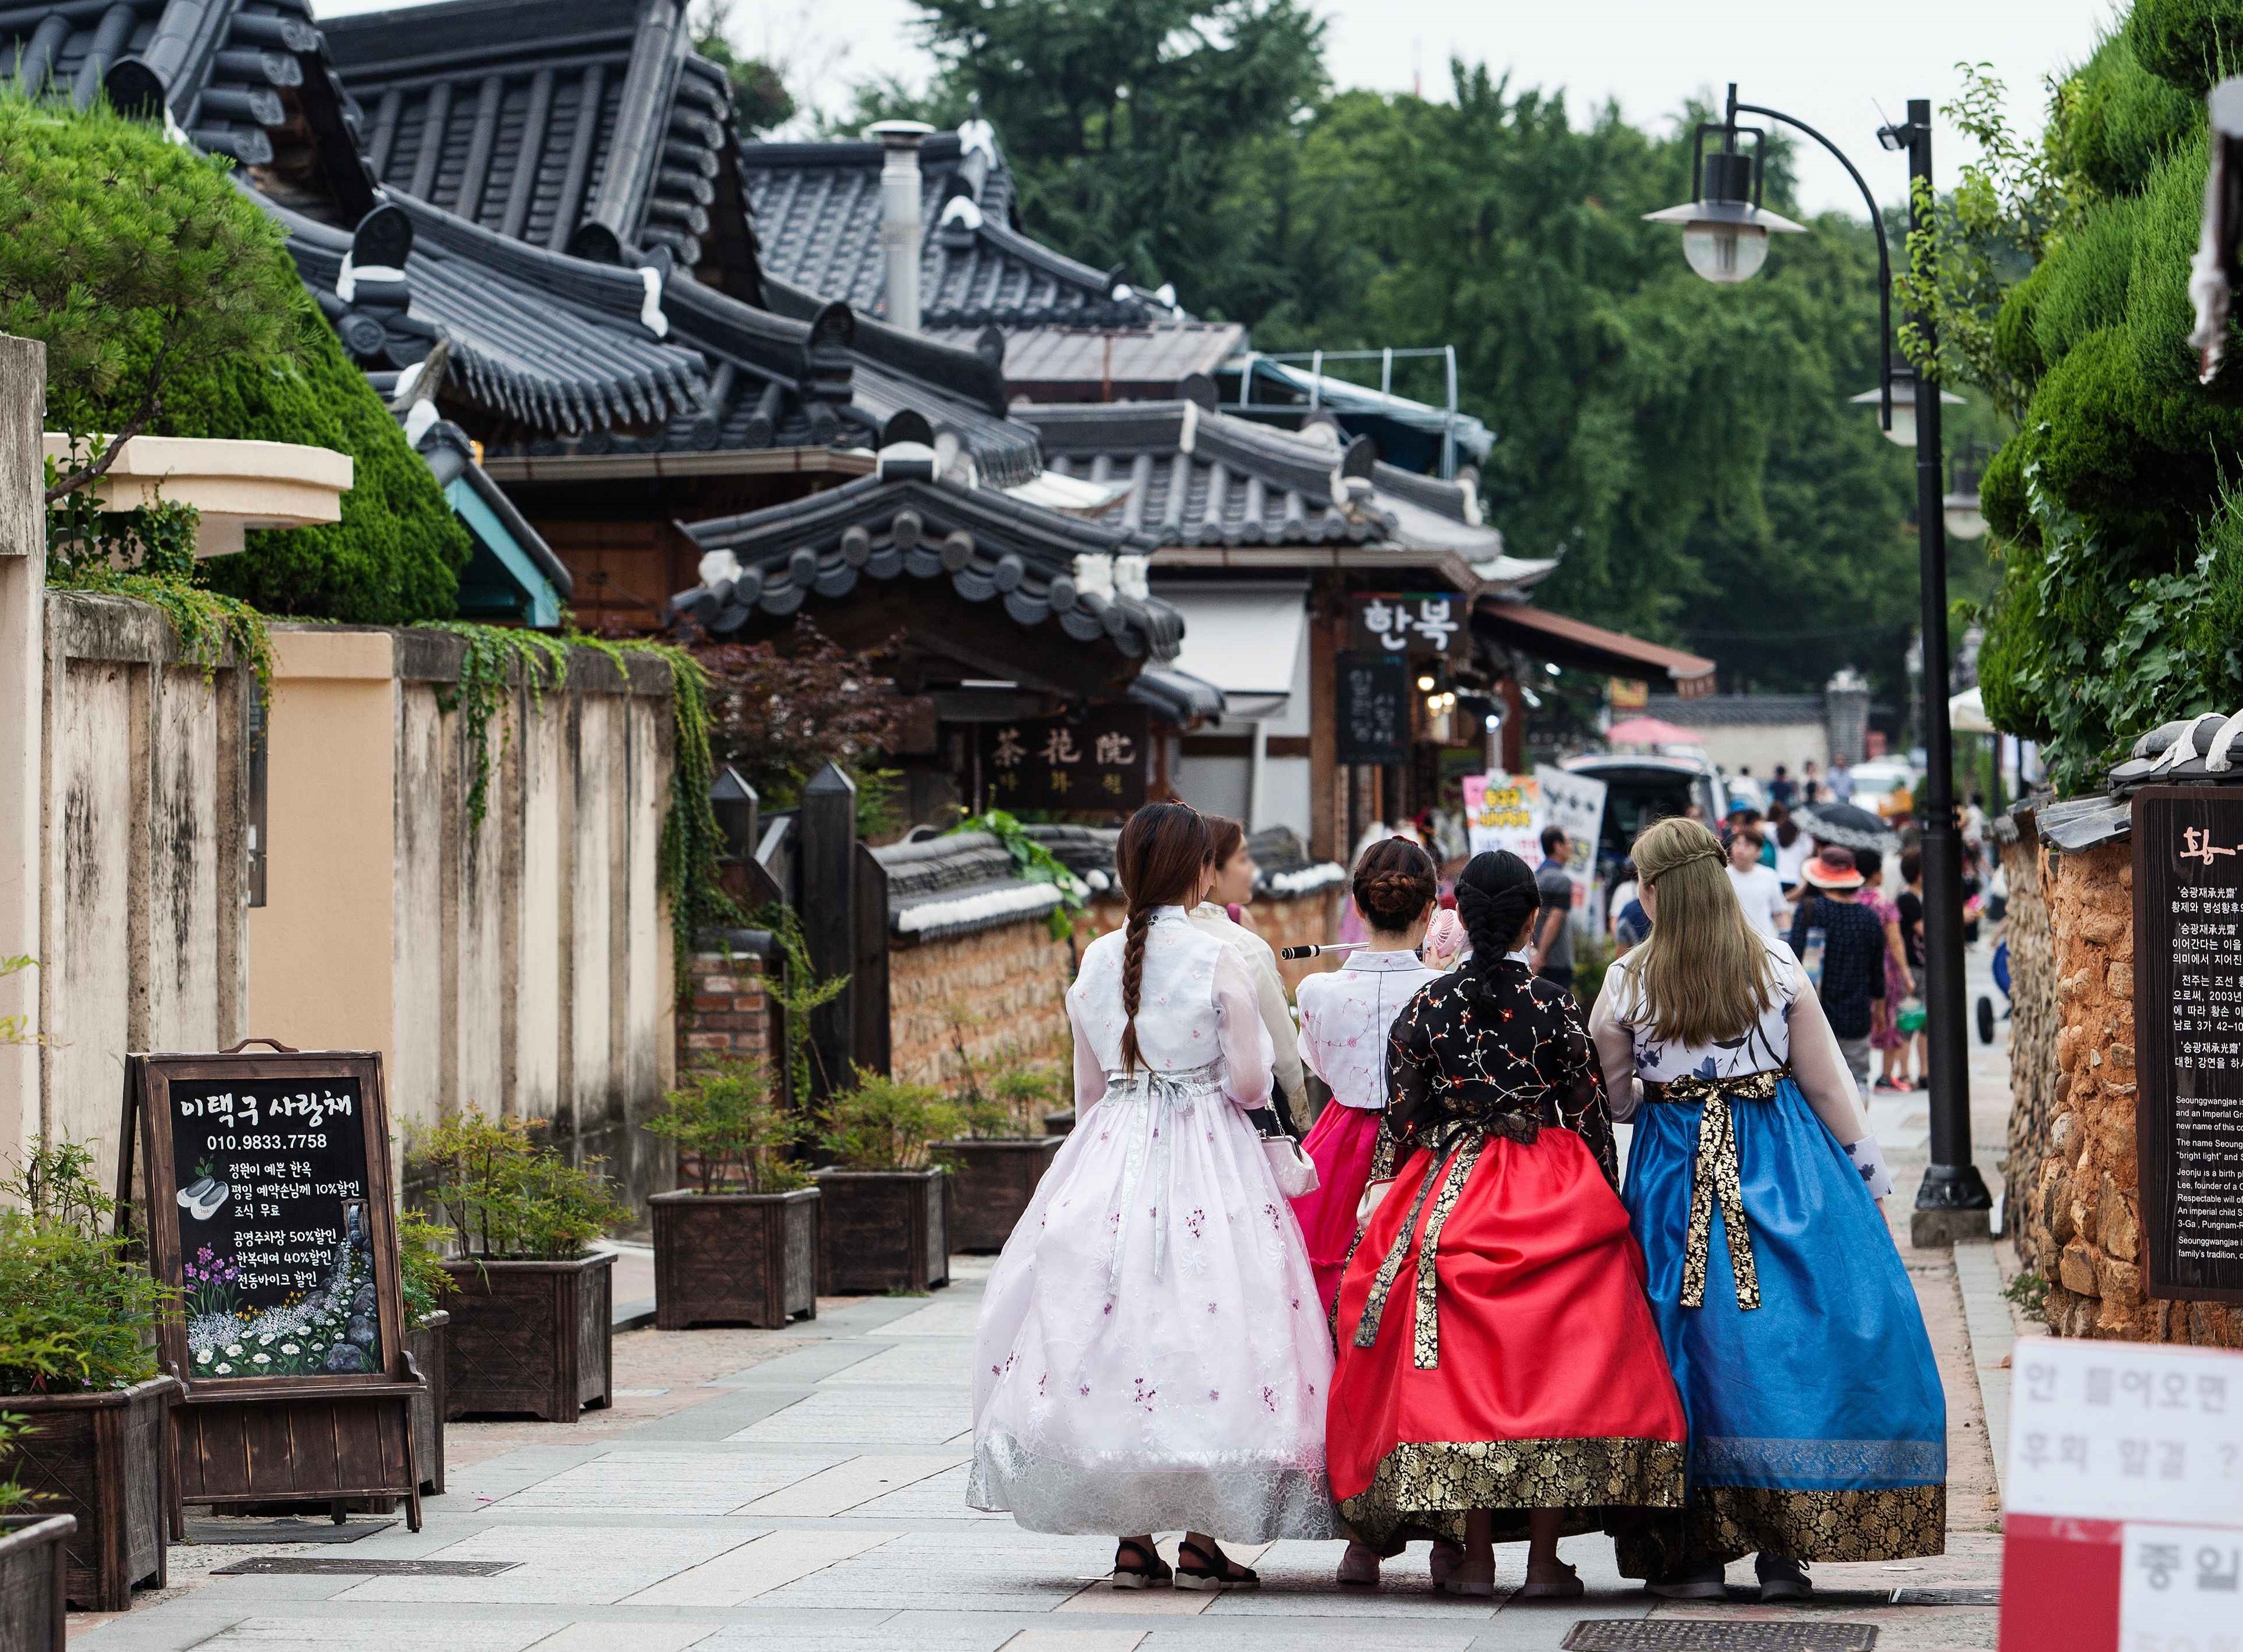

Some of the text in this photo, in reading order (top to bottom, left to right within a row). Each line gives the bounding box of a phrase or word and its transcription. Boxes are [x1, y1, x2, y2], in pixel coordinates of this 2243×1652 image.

[1362, 597, 1460, 652] 한복
[2180, 826, 2243, 865] 황
[2171, 901, 2243, 914] 황제와 명성황후
[2172, 938, 2219, 950] 이어간다는
[2172, 952, 2242, 966] 의미에서 지어진
[2182, 974, 2210, 987] 전주는
[2215, 976, 2233, 987] 조선
[2173, 990, 2242, 1003] 으로써, 2003년
[2173, 1005, 2182, 1016] 에
[2187, 1005, 2206, 1017] 따라
[2210, 1005, 2230, 1017] 황손
[2173, 1019, 2192, 1031] 남로
[2197, 1020, 2212, 1032] 3가
[2174, 1056, 2193, 1068] 대한
[2198, 1057, 2226, 1069] 강연을
[180, 1090, 352, 1128] 이택구 사랑채
[2213, 1122, 2222, 1131] of
[2222, 1123, 2235, 1131] this
[207, 1133, 327, 1150] 010.9833.7758
[2176, 1138, 2190, 1146] The
[229, 1161, 312, 1179] 정원이 예쁜 한옥
[2177, 1168, 2201, 1178] Jeonju
[2204, 1168, 2210, 1177] is
[2219, 1169, 2235, 1178] birth
[231, 1180, 359, 1200] 평일 예약손님께 10%할인
[2177, 1180, 2193, 1190] Lee,
[2194, 1181, 2222, 1190] founder
[2223, 1182, 2231, 1190] of
[2177, 1193, 2222, 1204] Respectable
[2223, 1195, 2235, 1203] will
[234, 1203, 280, 1219] 조식 무료
[2177, 1207, 2188, 1215] An
[2219, 1208, 2235, 1216] child
[2178, 1219, 2196, 1228] 3-Ga
[233, 1228, 337, 1247] 공영주차장 50%할인
[236, 1248, 332, 1269] 한복대여 40%할인
[2178, 1248, 2205, 1259] family's
[2206, 1250, 2237, 1259] tradition,
[236, 1271, 317, 1289] 전동바이크 할인
